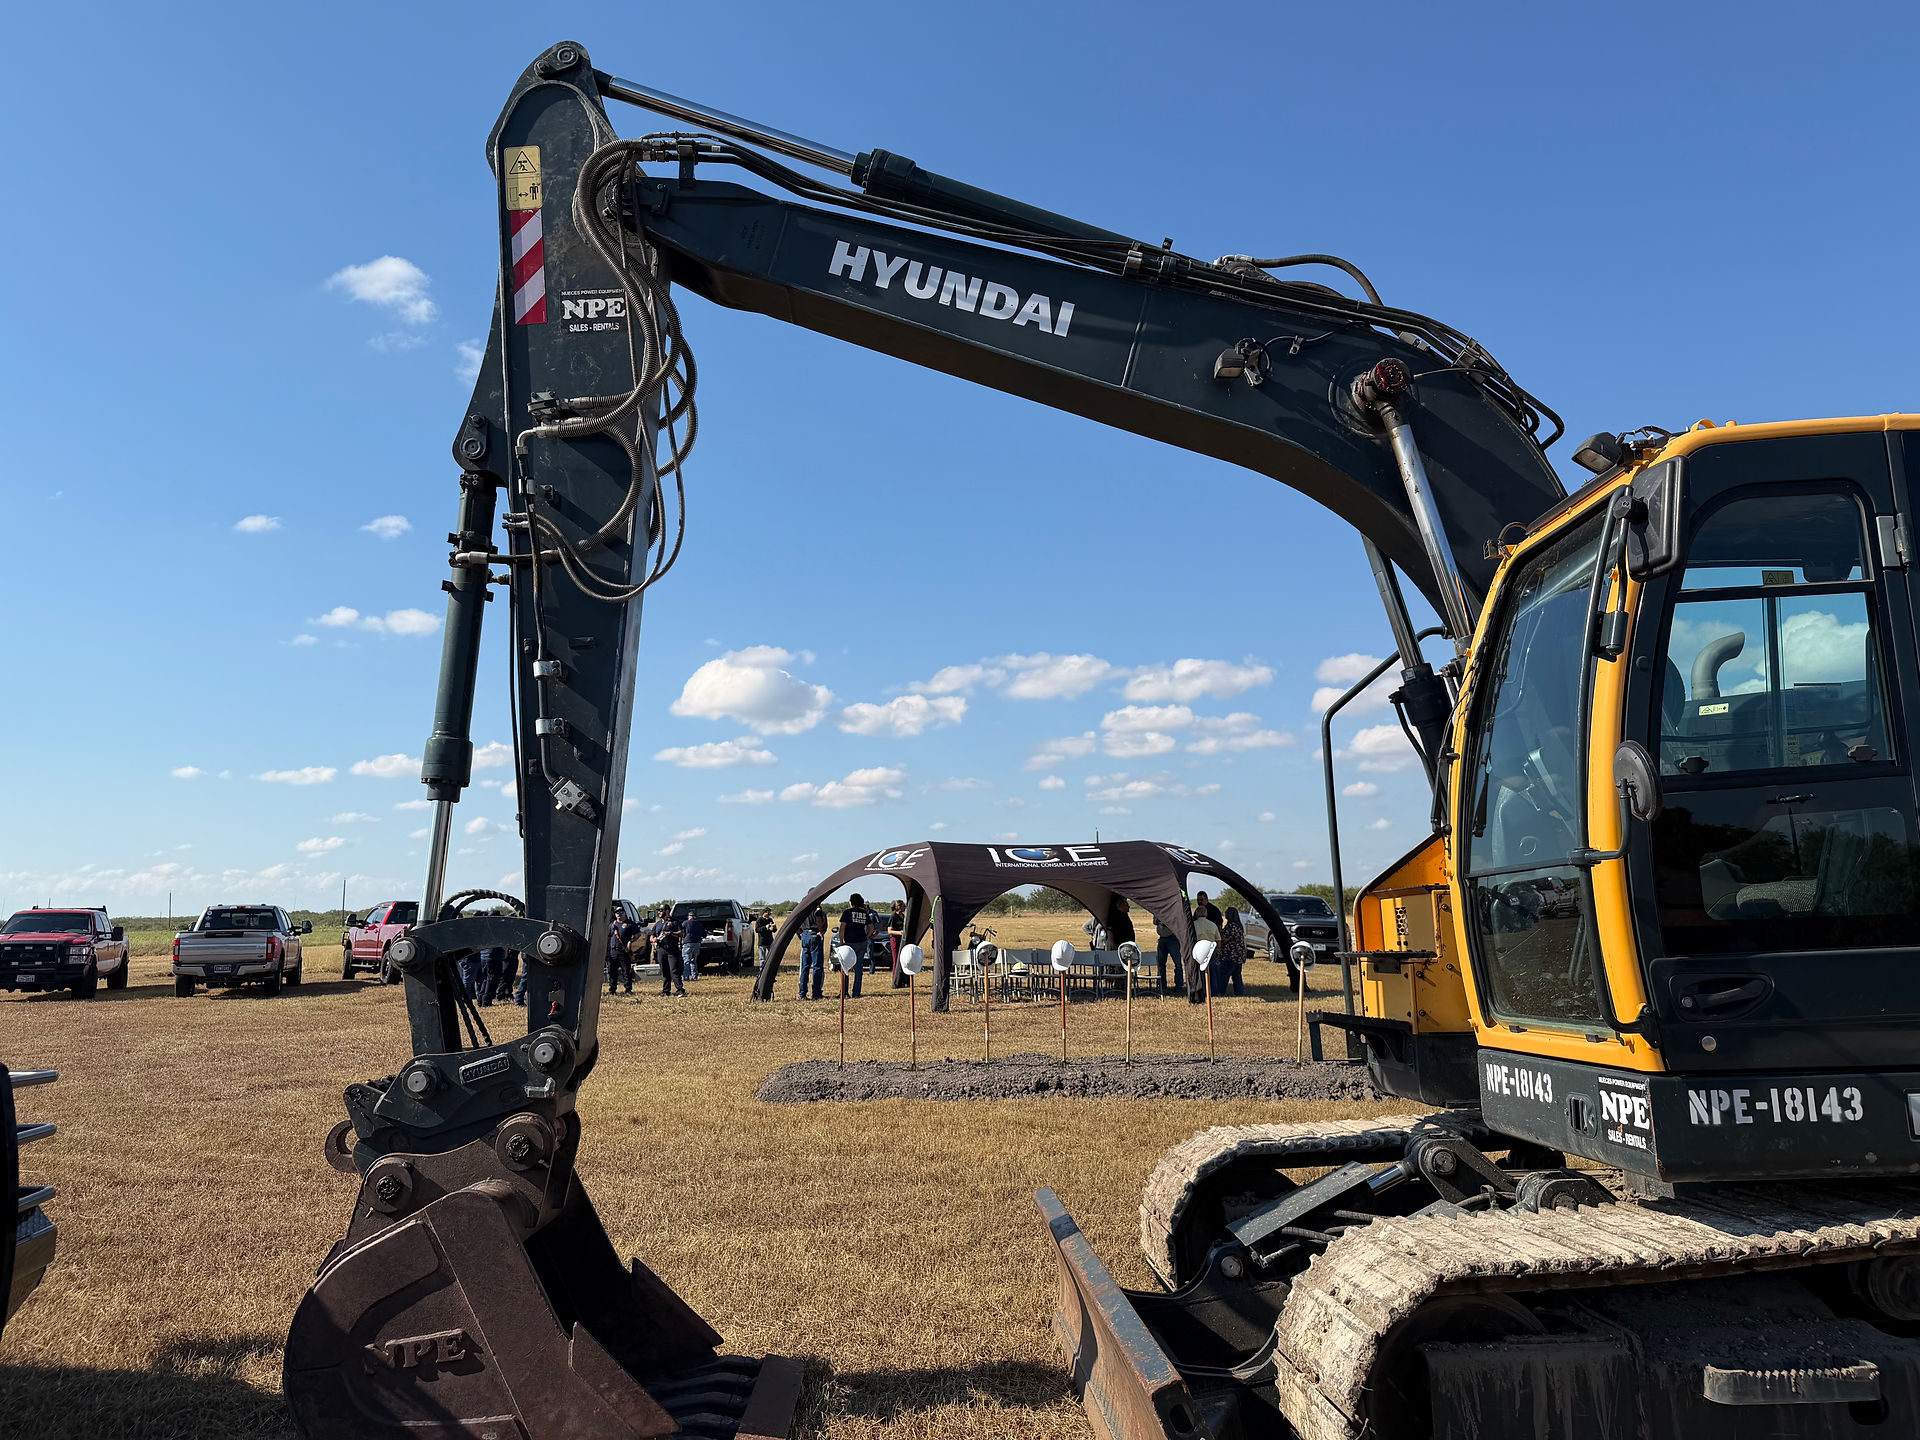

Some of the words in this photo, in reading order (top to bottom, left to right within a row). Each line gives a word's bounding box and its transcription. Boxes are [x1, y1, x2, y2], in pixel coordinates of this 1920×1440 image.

[828, 240, 1075, 337] HYUNDAI
[561, 297, 626, 320] NPE
[569, 323, 589, 332] SALES
[593, 322, 620, 331] RENTALS
[865, 847, 931, 868] ICE
[987, 845, 1107, 863] ICE
[463, 1059, 508, 1080] HYUNDAI
[1485, 1063, 1553, 1104] NPE-18143
[1599, 1089, 1650, 1130] NPE
[1688, 1087, 1864, 1125] NPE-18143
[1607, 1129, 1623, 1143] SALES
[1625, 1132, 1647, 1149] RENTALS
[363, 1328, 466, 1376] NPE
